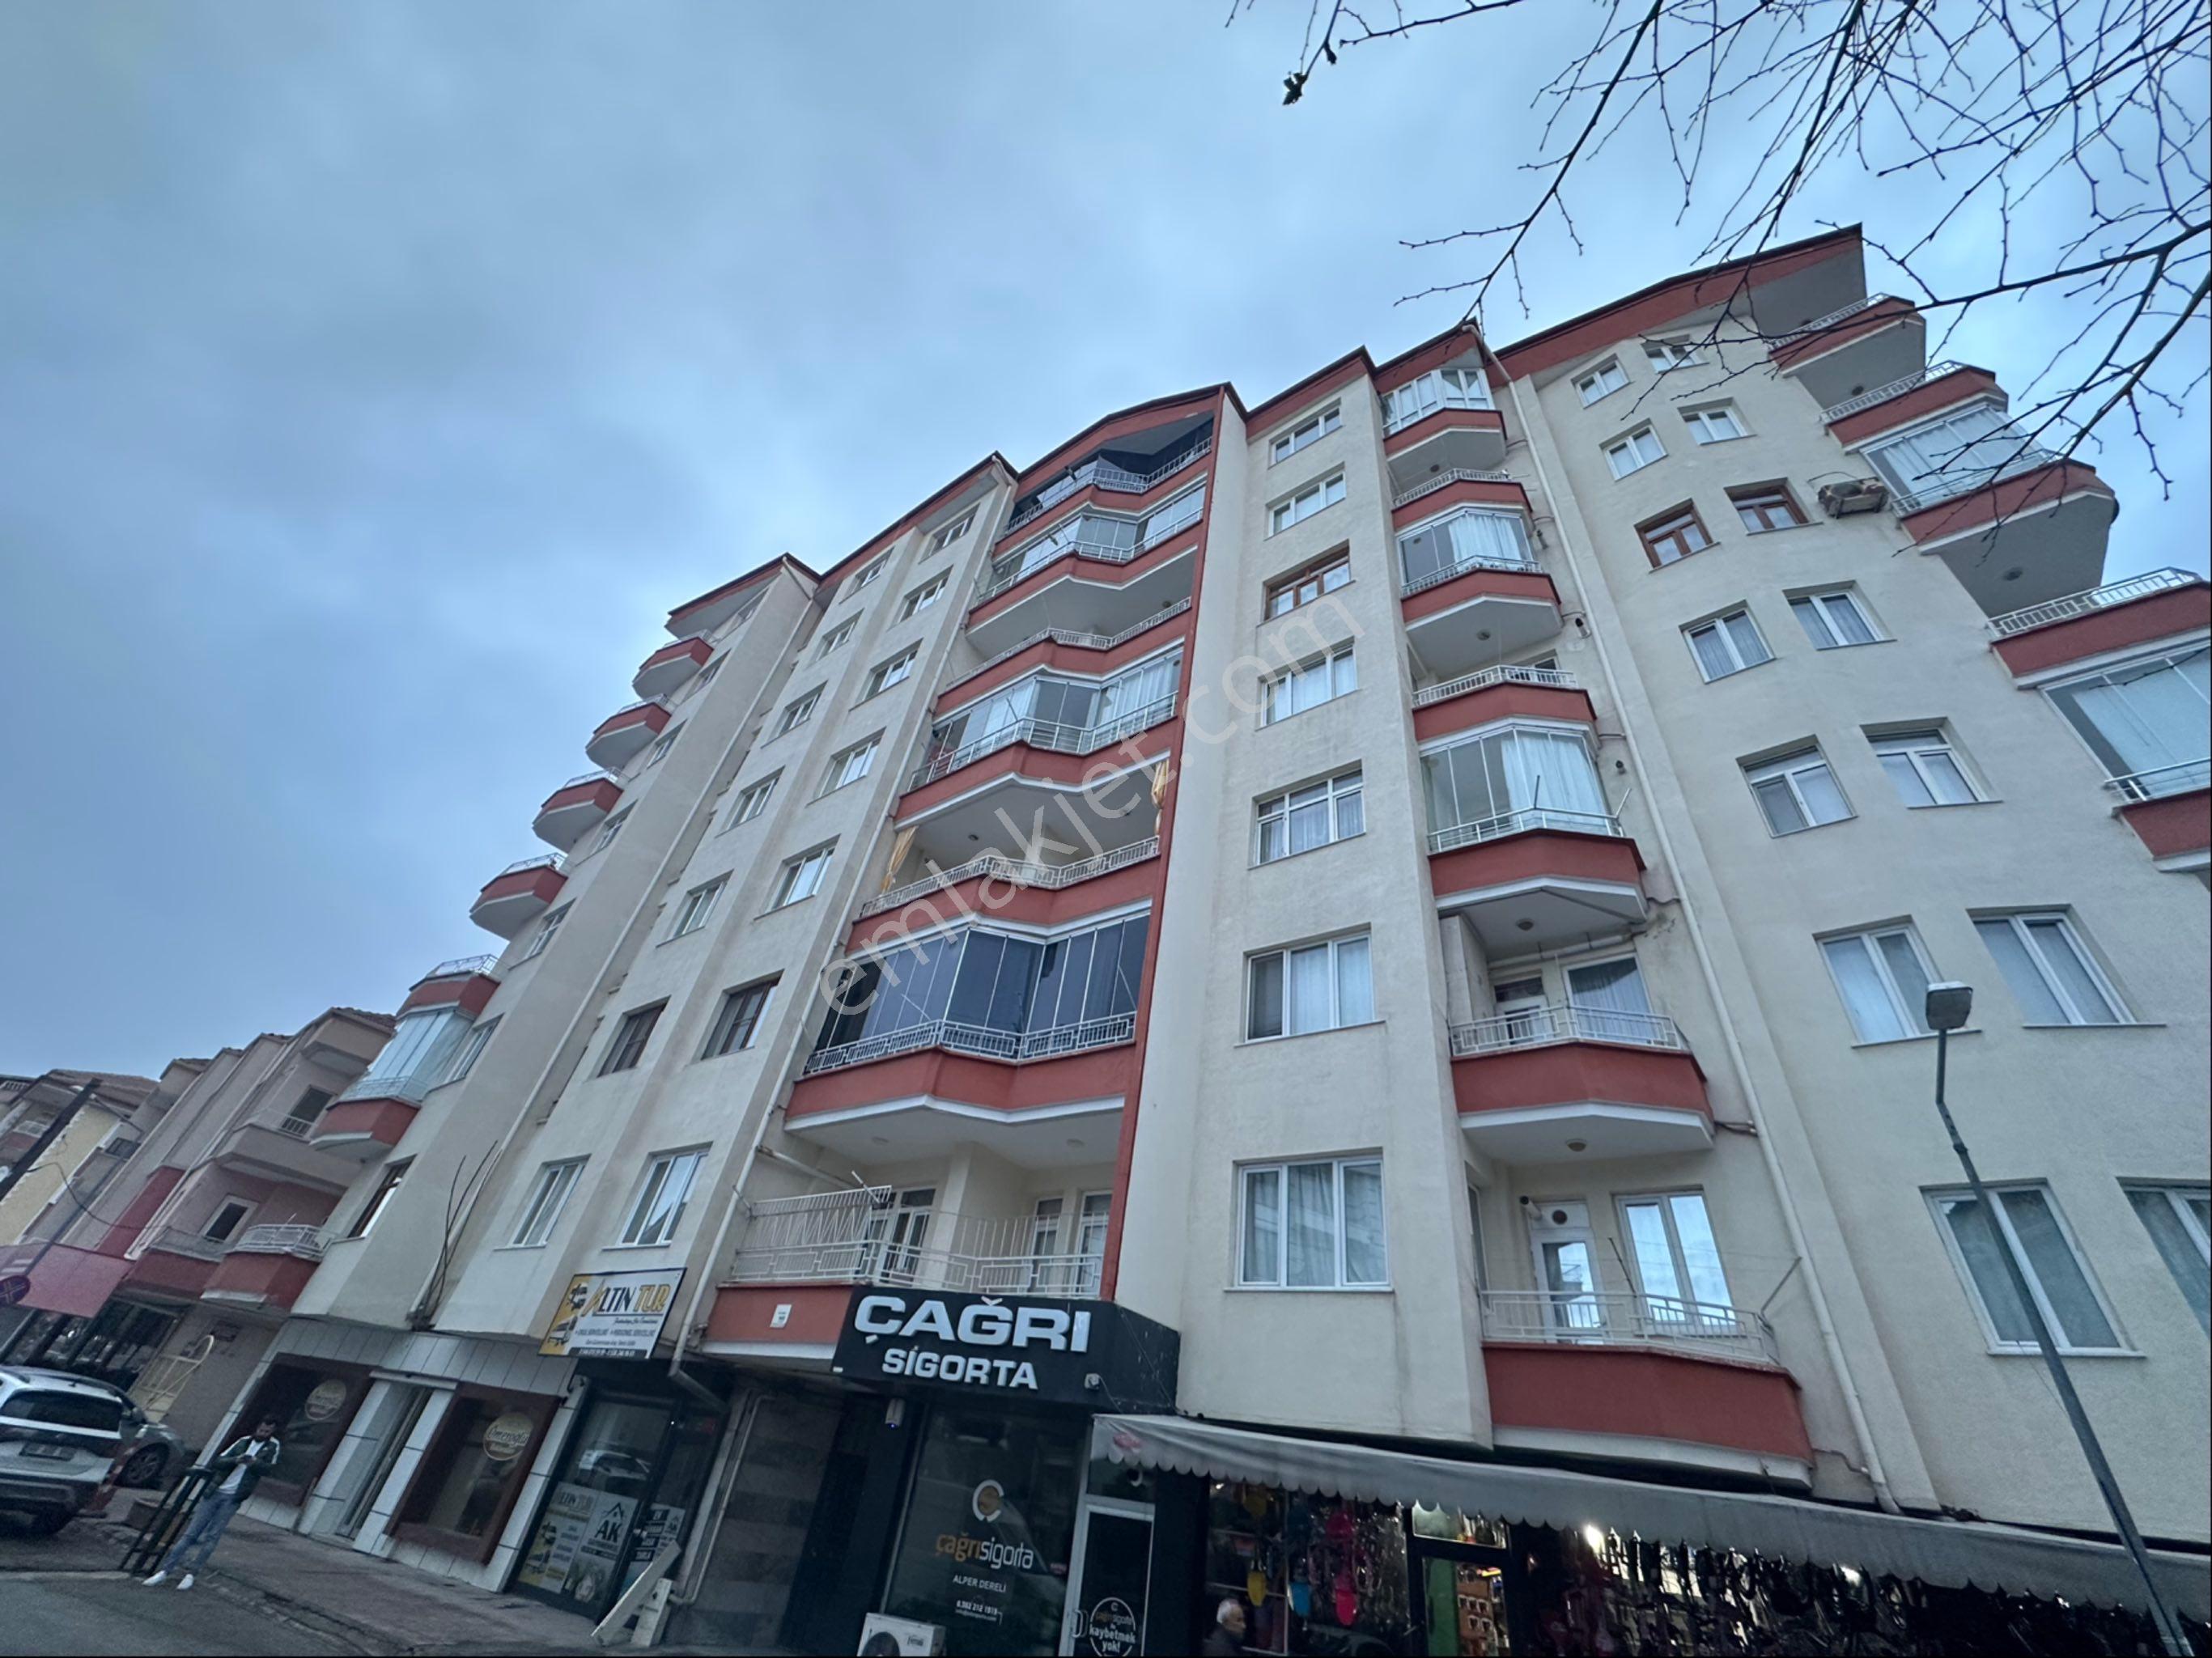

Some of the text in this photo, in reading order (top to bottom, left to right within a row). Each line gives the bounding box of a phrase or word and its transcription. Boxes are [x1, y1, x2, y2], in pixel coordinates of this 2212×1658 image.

[580, 1278, 671, 1317] ALTIN TUR
[855, 1295, 1091, 1353] ÇAĞRI
[882, 1345, 1038, 1390] SİGORTA
[594, 1520, 622, 1542] AK
[953, 1574, 1007, 1593] ALPER DERELİ
